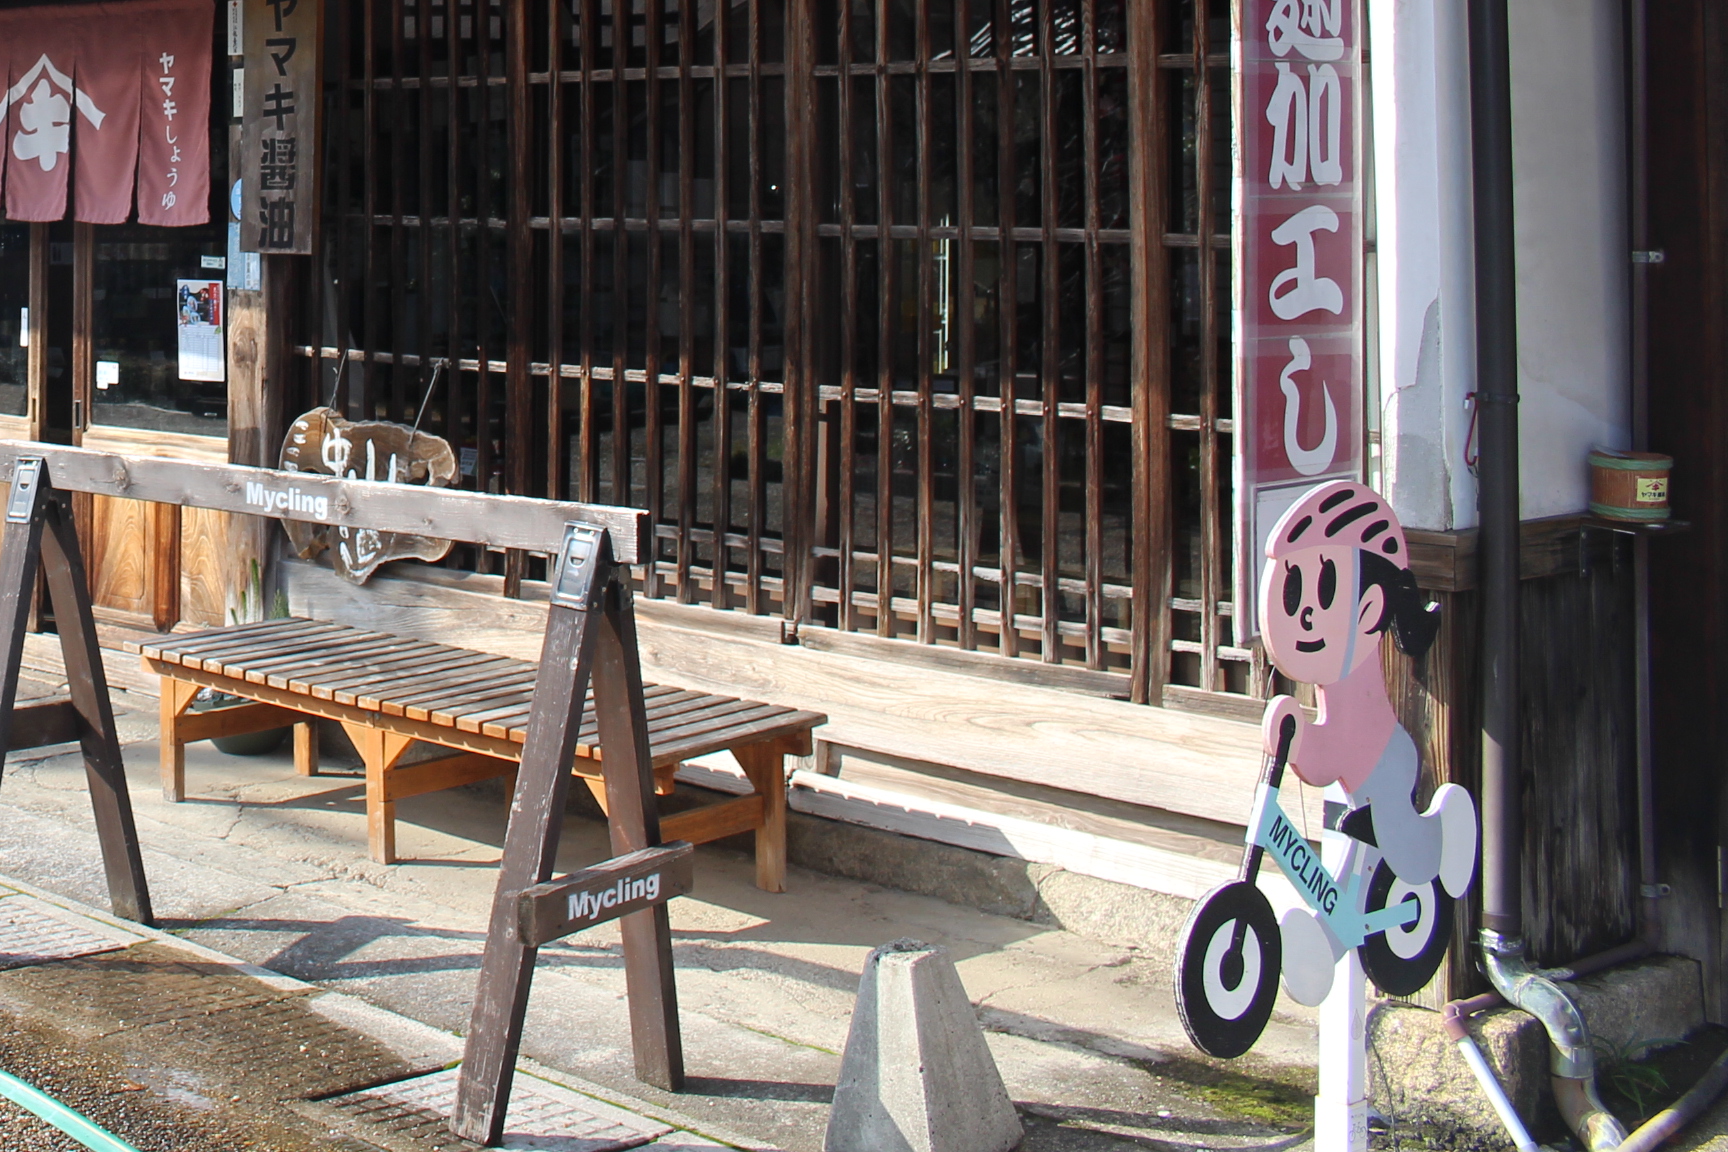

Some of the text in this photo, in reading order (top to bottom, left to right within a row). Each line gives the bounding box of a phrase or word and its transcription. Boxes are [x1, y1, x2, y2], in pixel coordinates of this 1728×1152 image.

[159, 51, 182, 211] ヤマキしょうゆ
[245, 481, 328, 521] Mycling
[568, 872, 661, 921] Mycling
[1268, 814, 1338, 917] MYCLING
